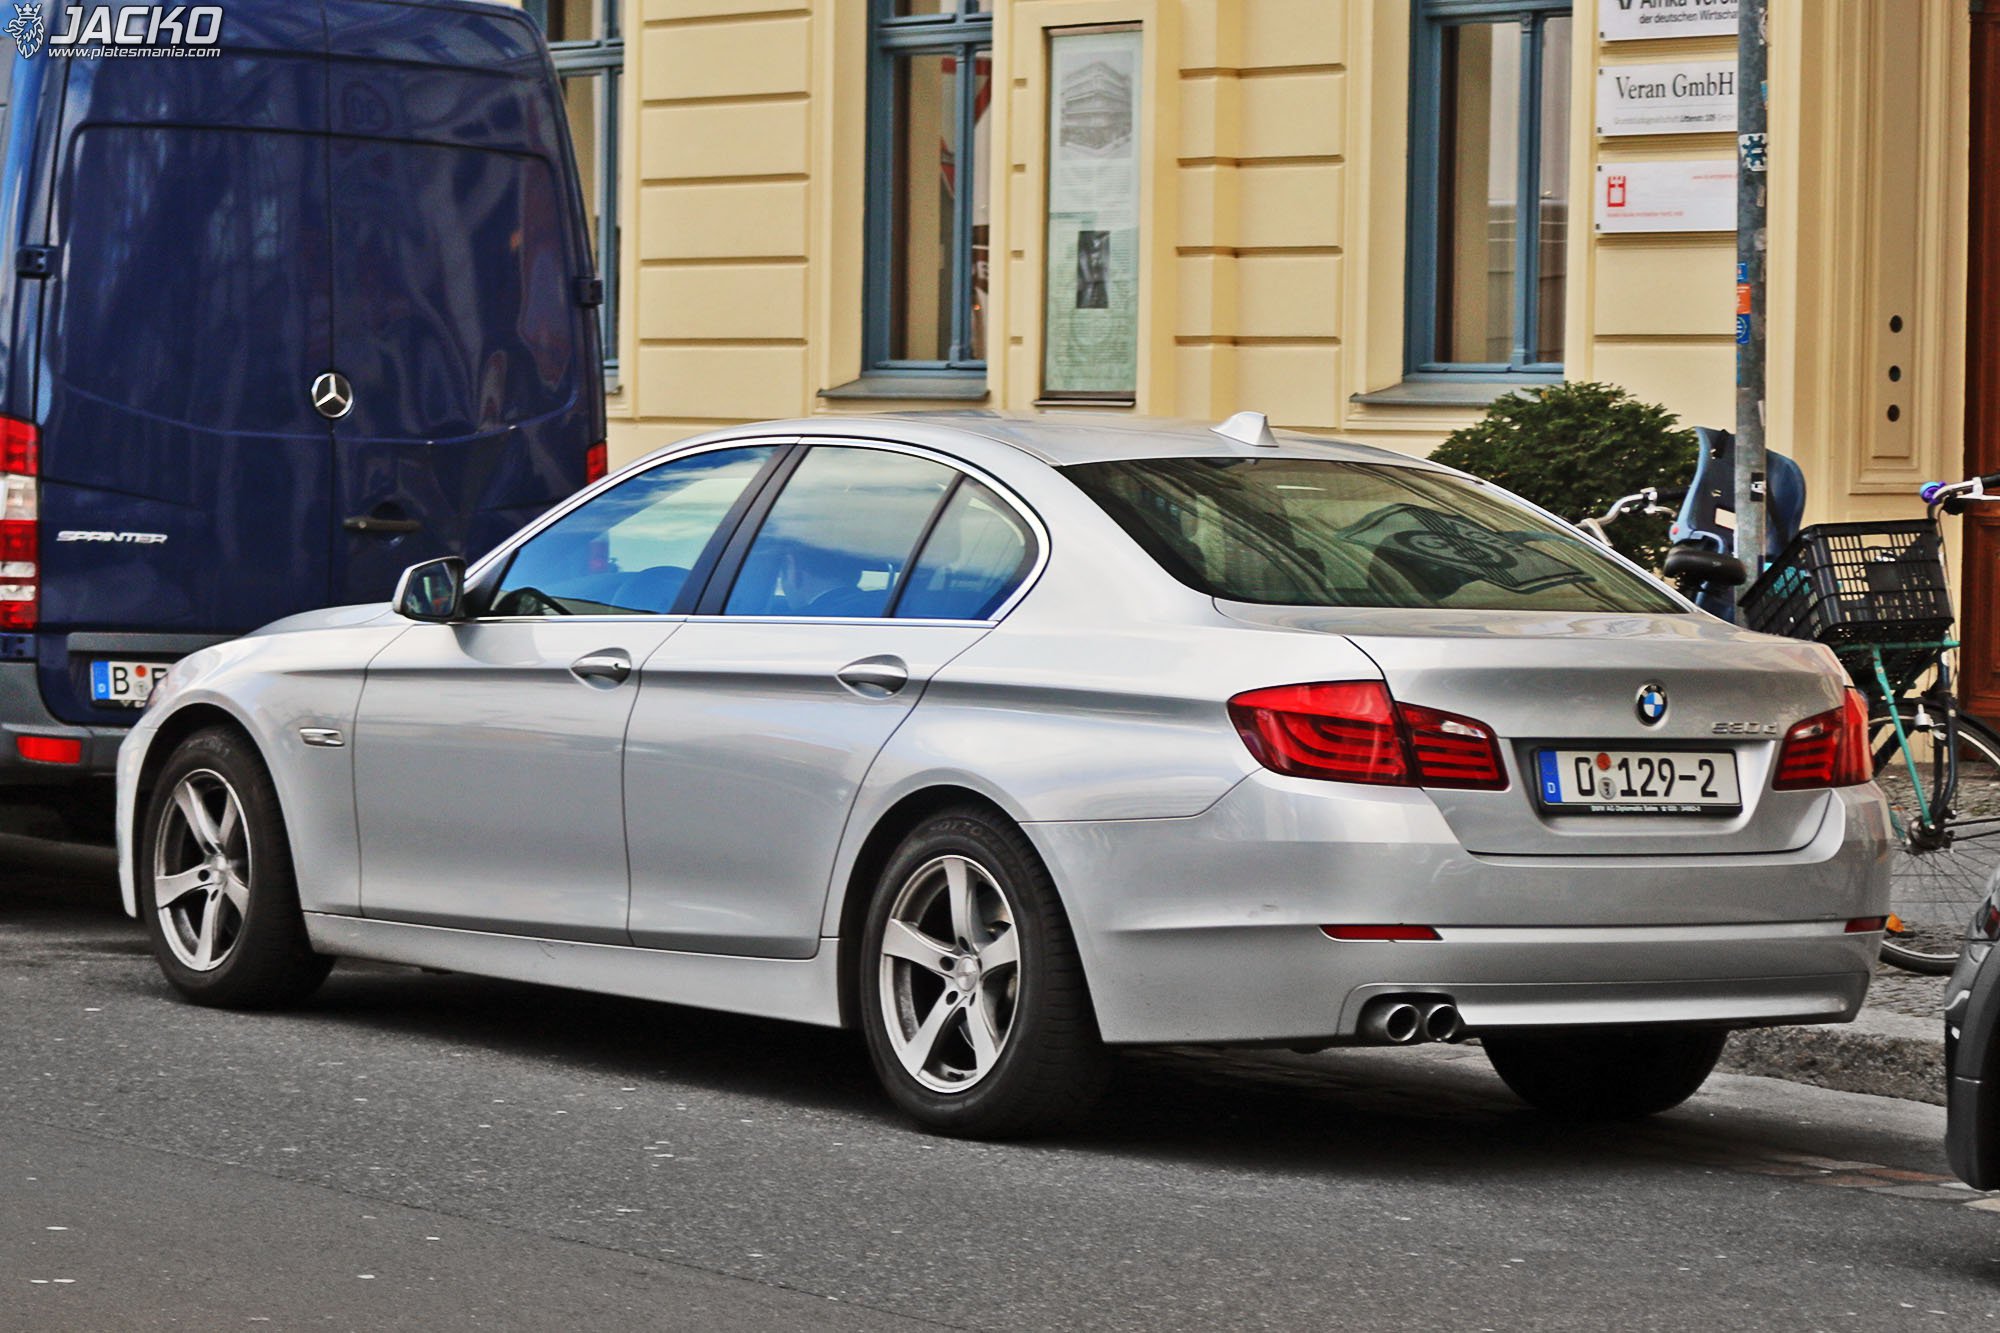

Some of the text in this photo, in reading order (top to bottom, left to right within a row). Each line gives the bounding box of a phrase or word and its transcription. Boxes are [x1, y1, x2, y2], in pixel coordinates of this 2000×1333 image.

[1654, 12, 1697, 23] deutschen
[1616, 72, 1734, 99] Veran GmbH
[56, 530, 168, 544] SPRINTER
[113, 666, 130, 694] B
[1617, 757, 1718, 797] 129-2
